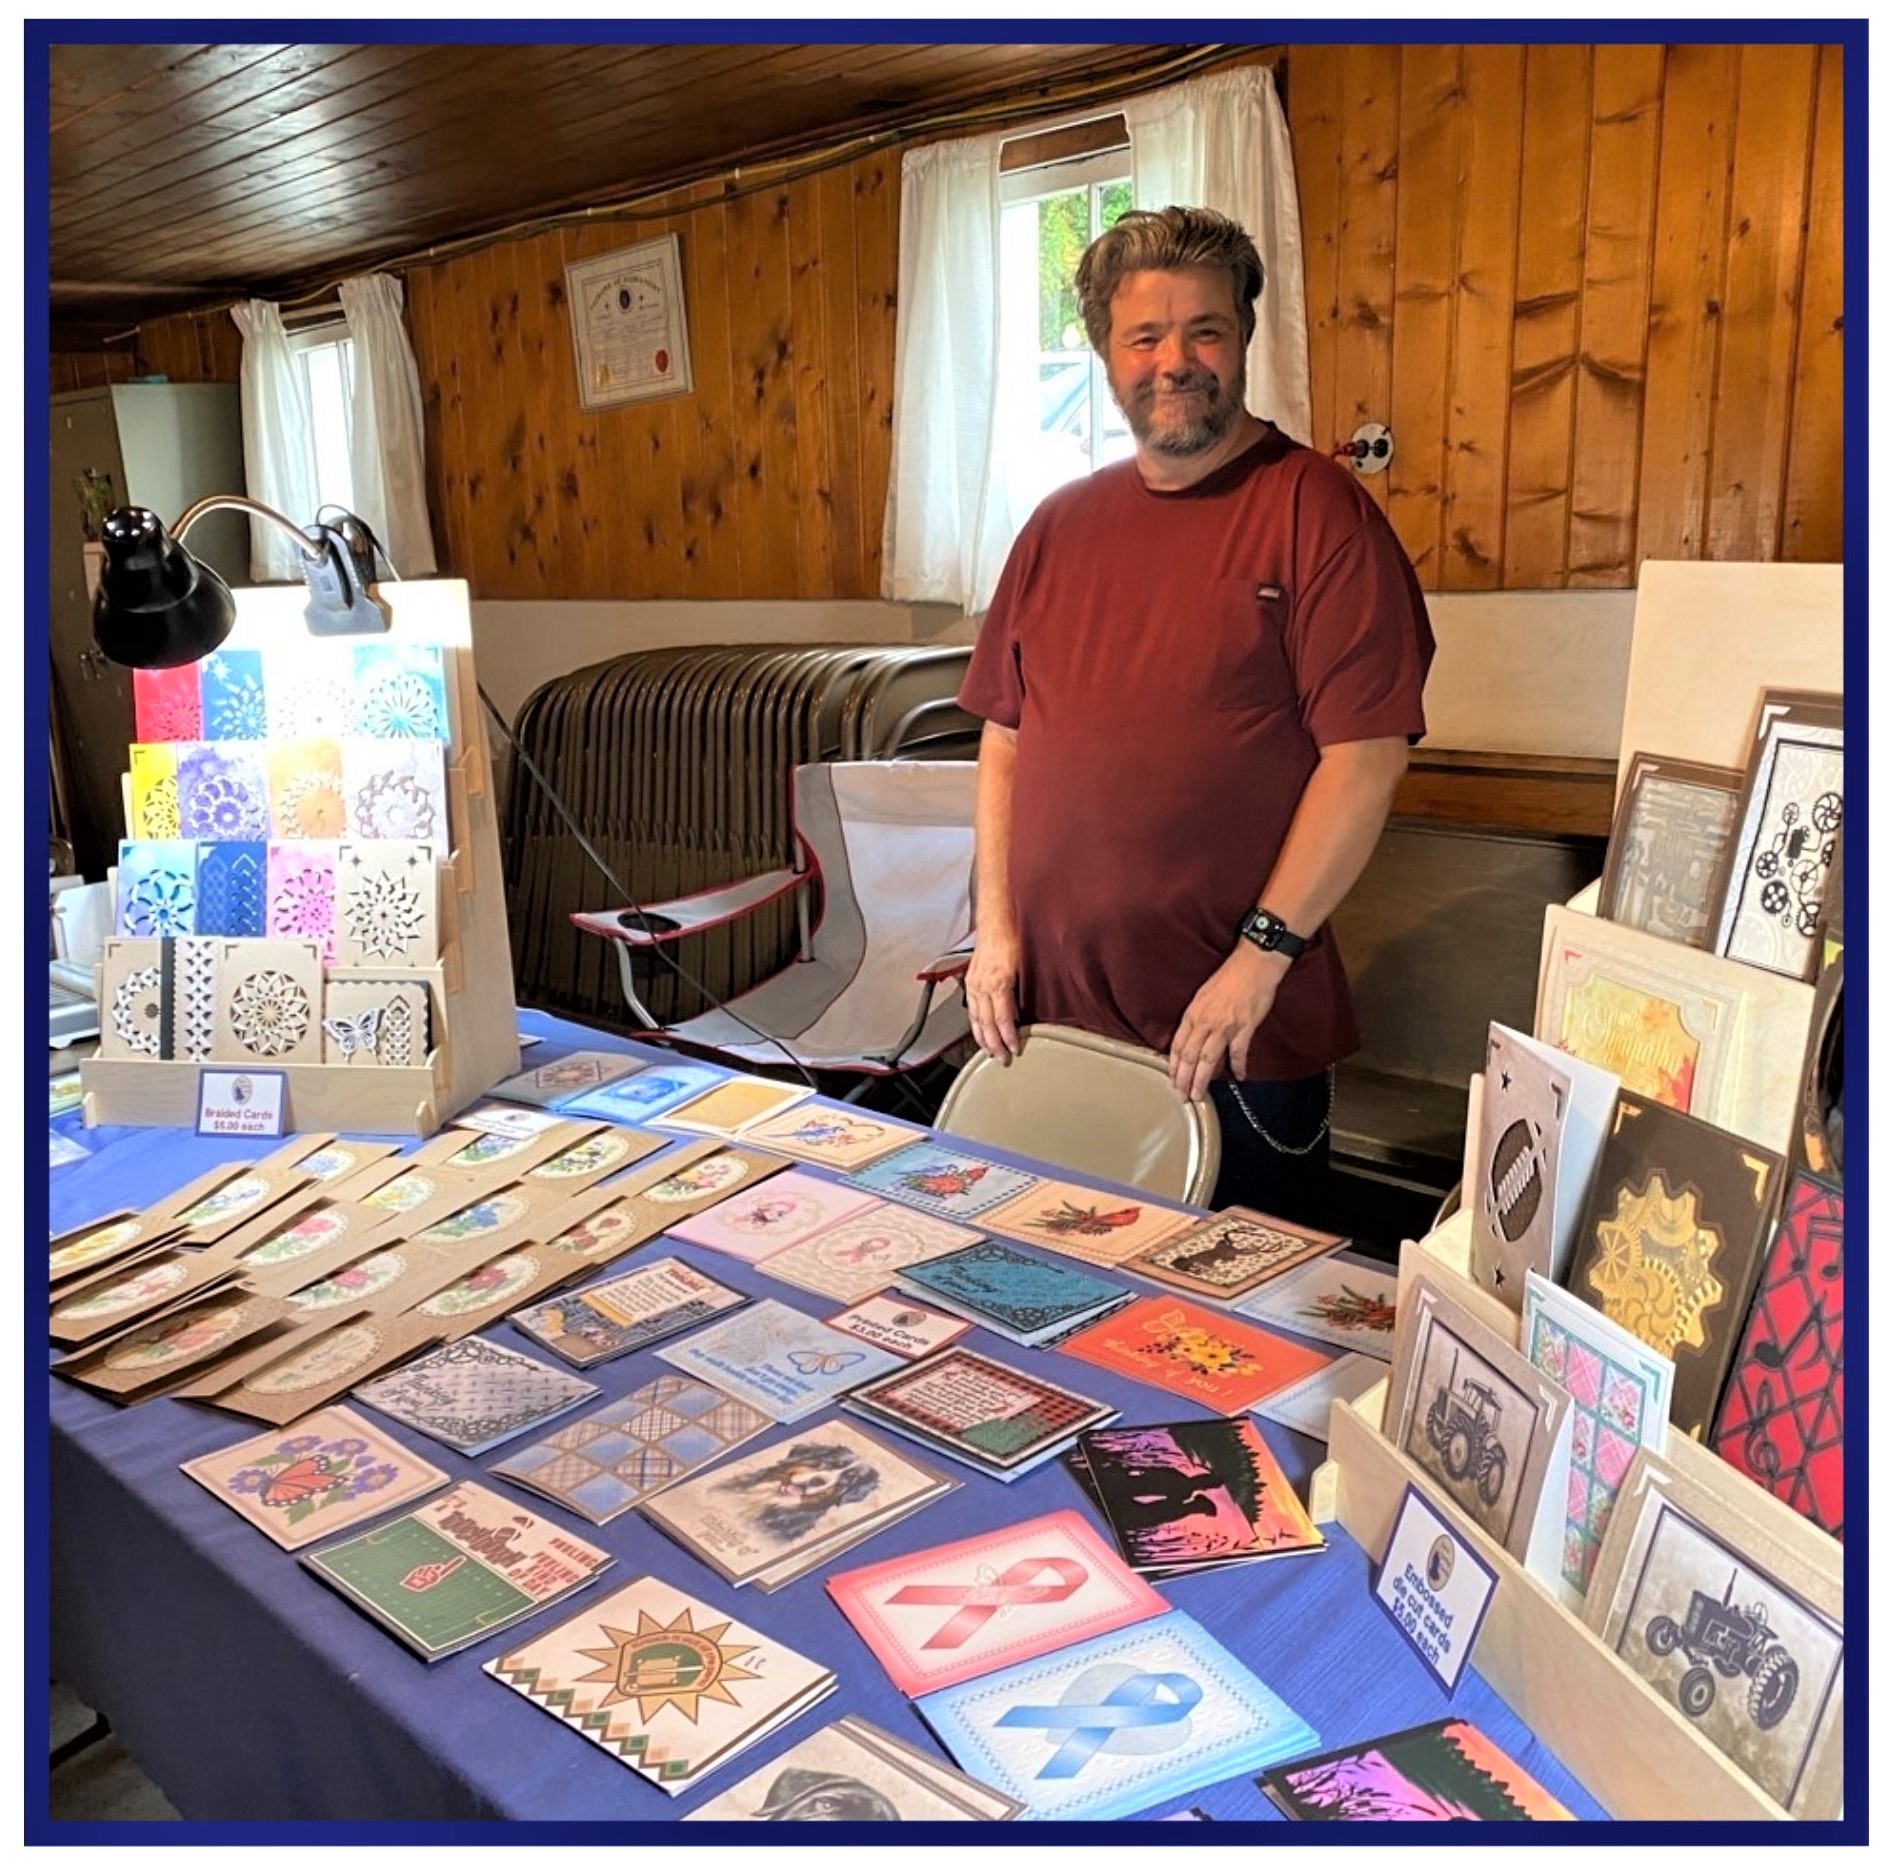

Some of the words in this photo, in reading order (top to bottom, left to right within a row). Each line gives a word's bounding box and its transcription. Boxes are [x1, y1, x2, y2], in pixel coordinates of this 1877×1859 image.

[204, 1107, 241, 1118] Braided
[244, 1109, 273, 1119] Cards
[241, 1121, 266, 1131] each
[848, 1314, 893, 1333] Printed
[893, 1329, 930, 1345] Cards
[882, 1336, 913, 1349] each
[531, 1551, 580, 1584] FEELING
[548, 1537, 598, 1568] FEELING
[507, 1568, 528, 1581] OF
[1403, 1562, 1454, 1630] Embossed
[1392, 1576, 1407, 1597] die
[1407, 1594, 1425, 1617] cut
[1422, 1613, 1452, 1655] cards
[1415, 1632, 1440, 1666] each
